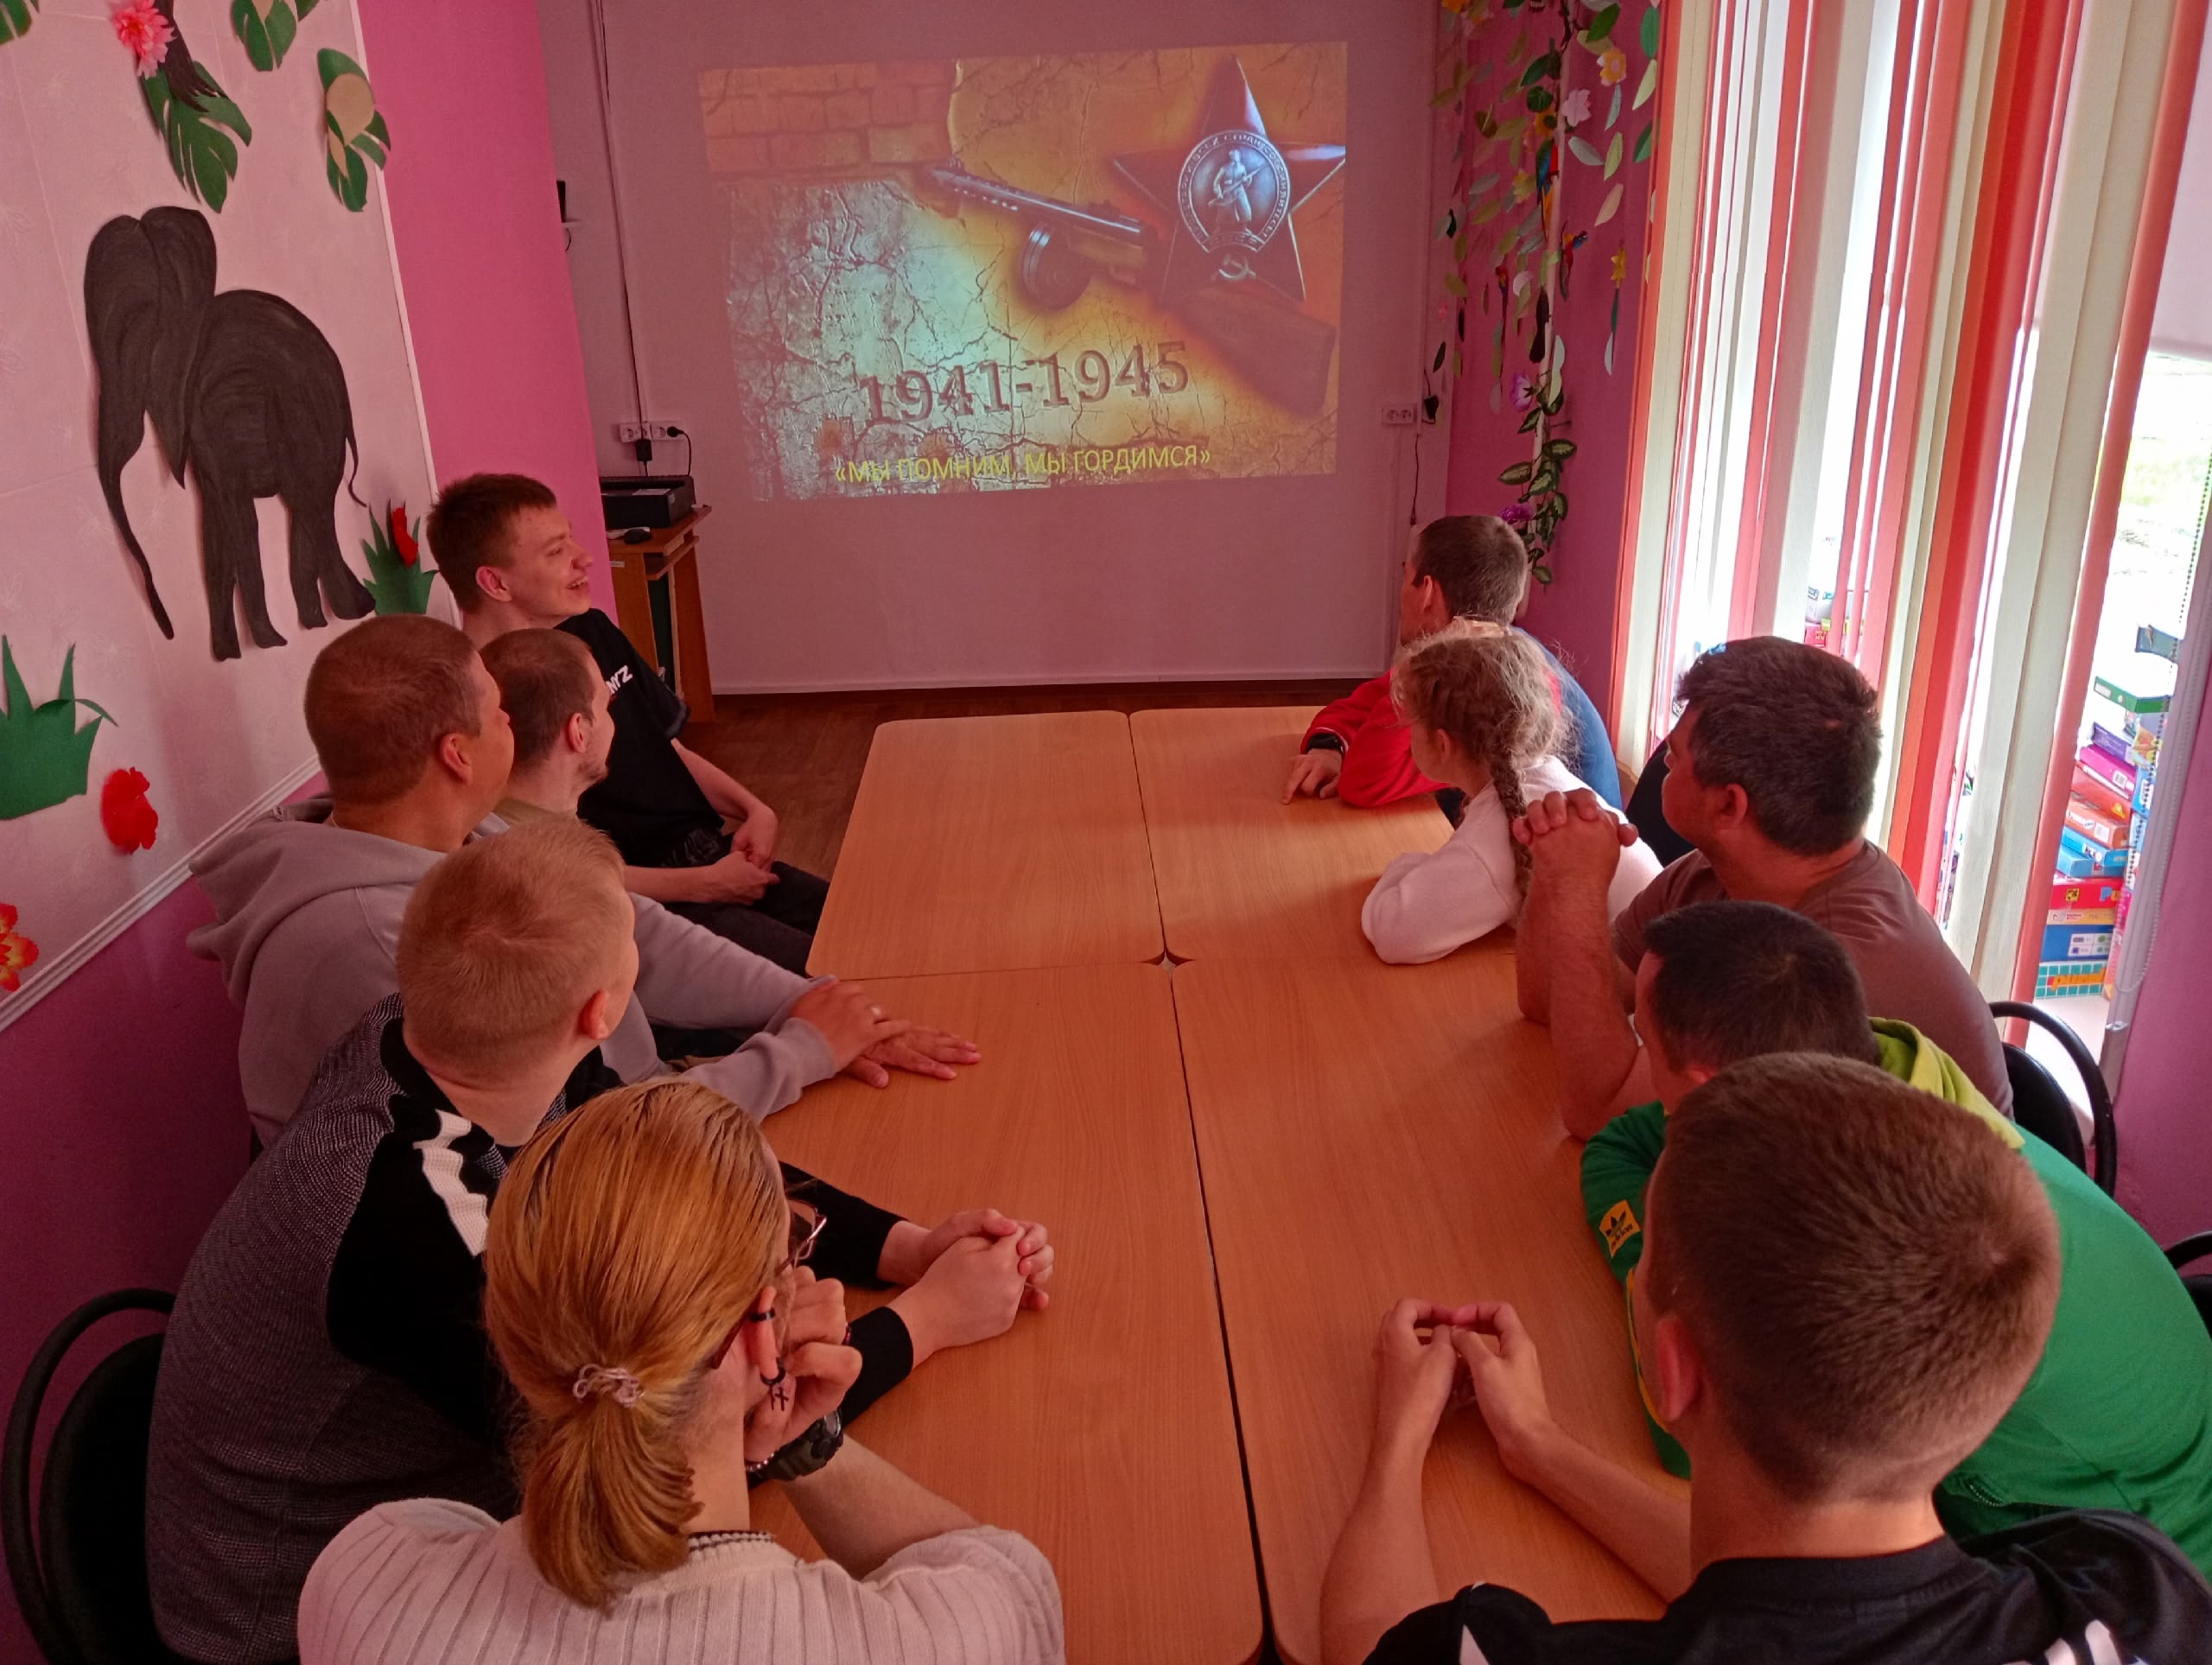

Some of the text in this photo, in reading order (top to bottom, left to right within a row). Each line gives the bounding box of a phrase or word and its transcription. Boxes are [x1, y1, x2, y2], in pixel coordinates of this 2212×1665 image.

[862, 341, 1189, 423] 1941-1945
[836, 444, 1211, 484] «МЫ ПОМНИМ, МЫ ГОРДИМСЯ»
